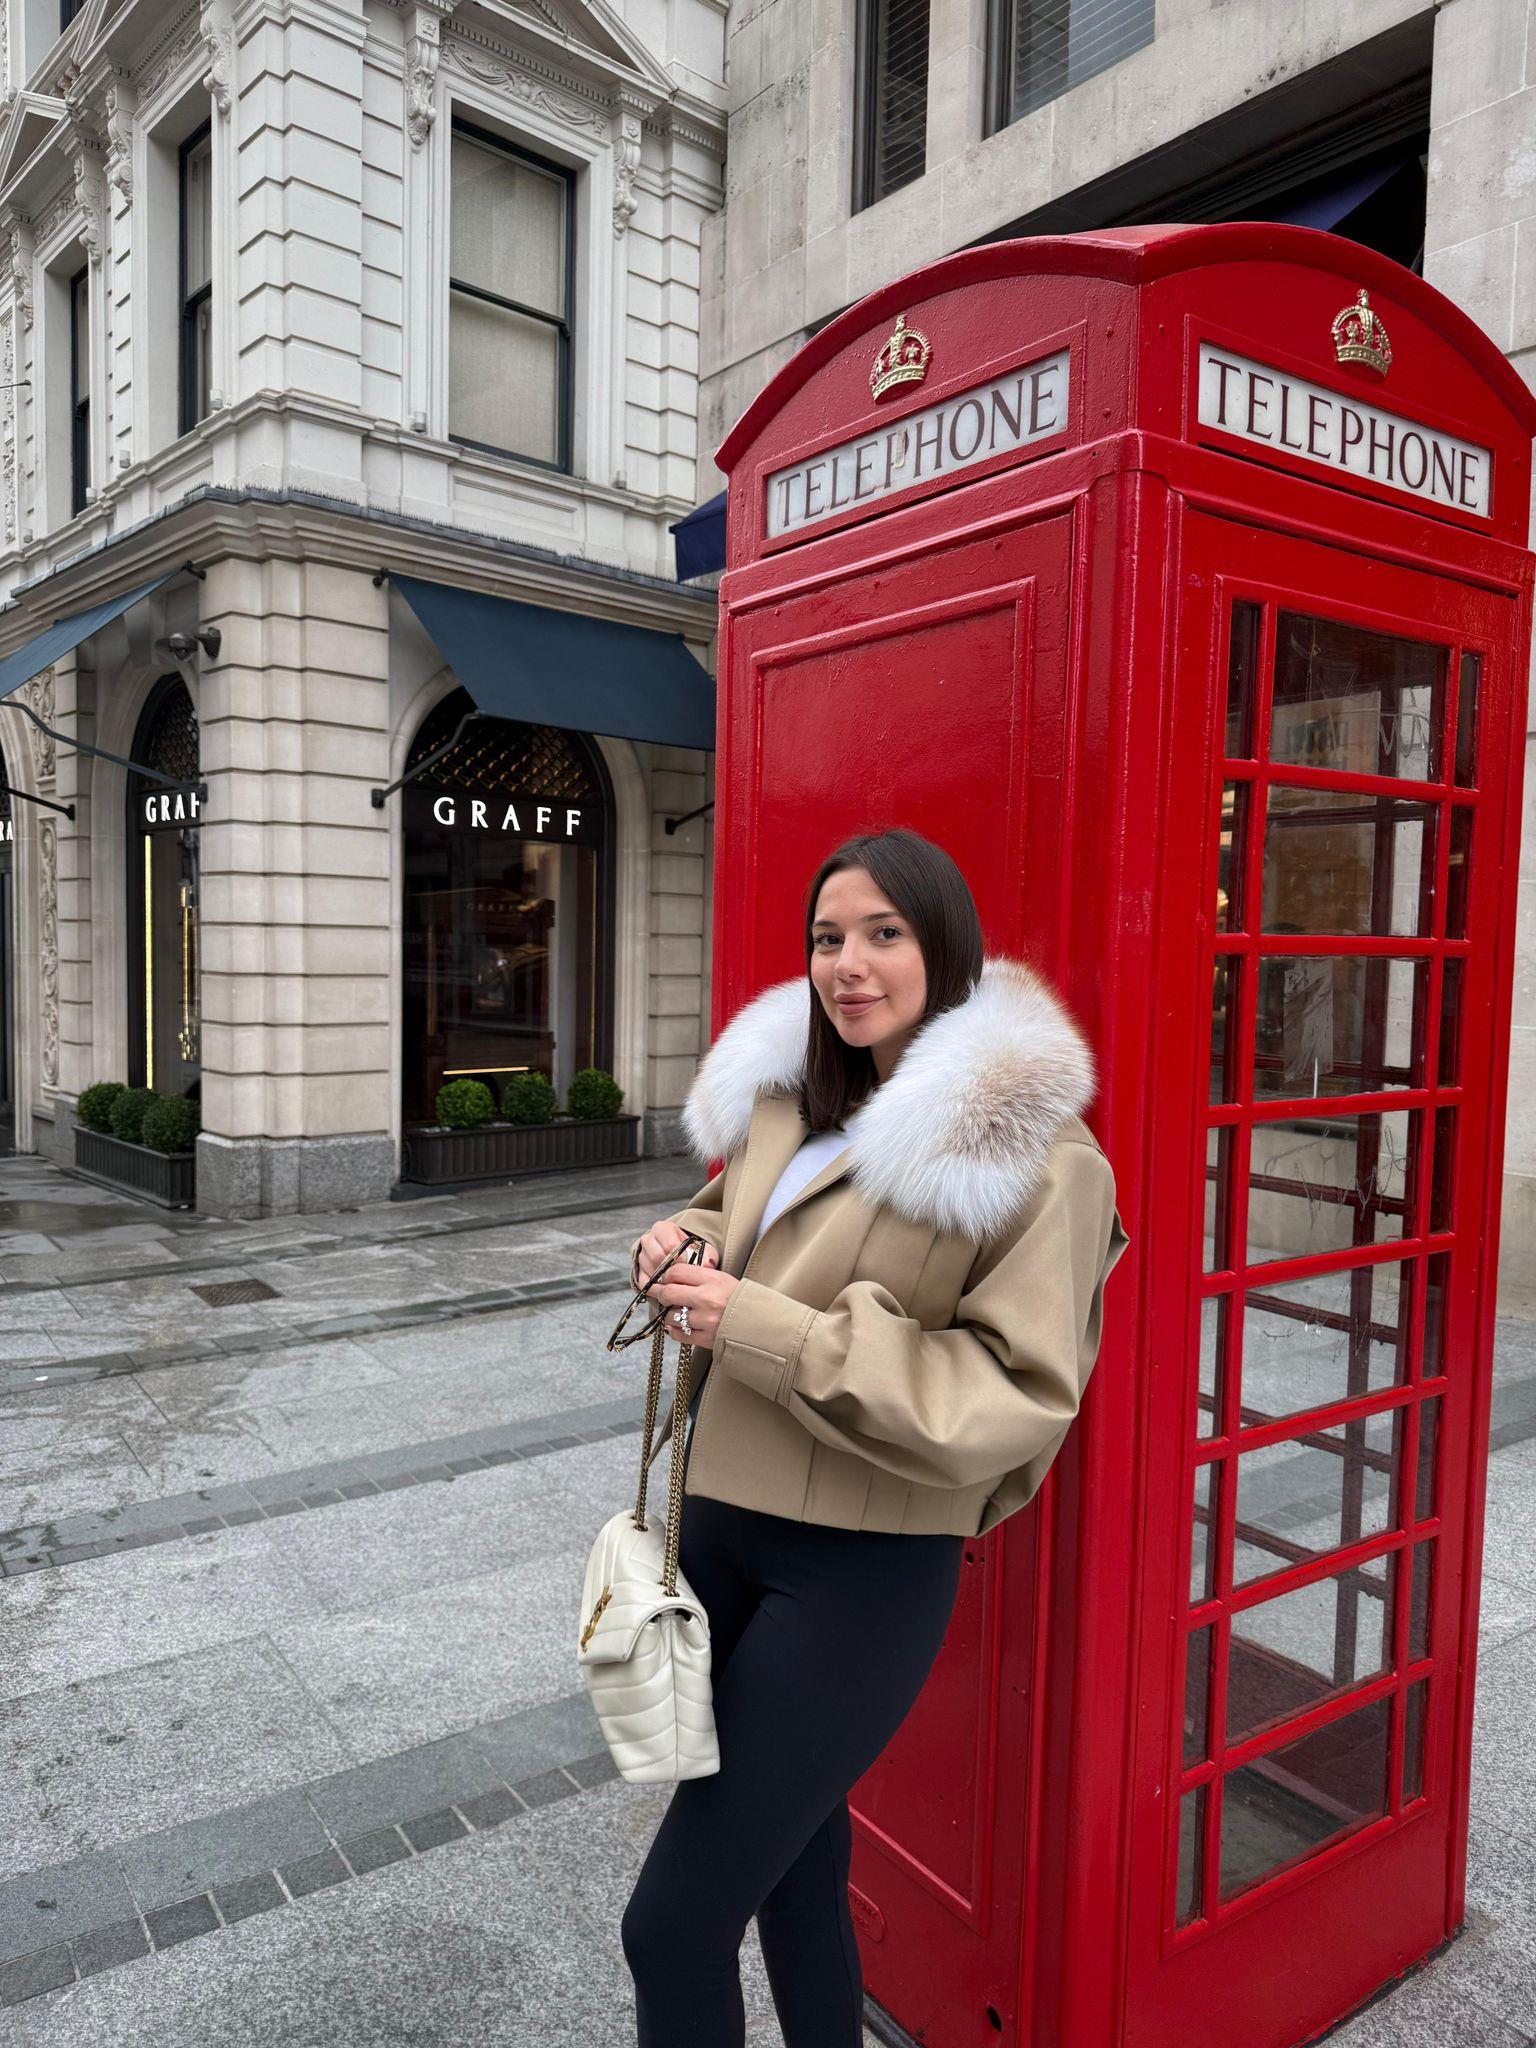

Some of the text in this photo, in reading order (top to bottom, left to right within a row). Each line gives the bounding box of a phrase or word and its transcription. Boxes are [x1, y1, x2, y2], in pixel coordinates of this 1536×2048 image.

[777, 365, 1059, 528] TELEPHONE
[1207, 357, 1479, 508] TELEPHONE
[433, 796, 581, 835] GRAFF
